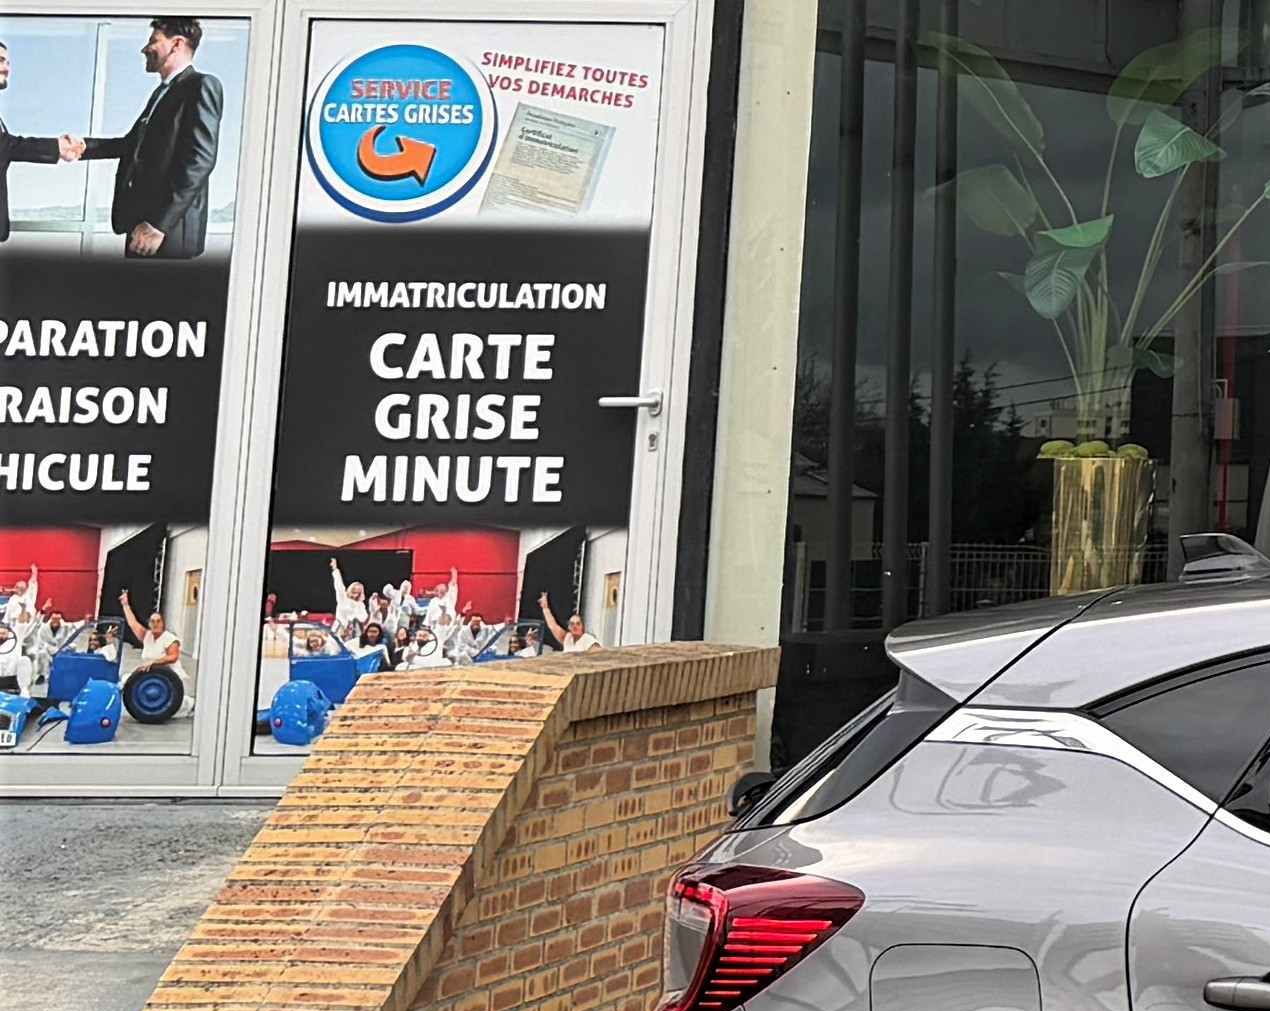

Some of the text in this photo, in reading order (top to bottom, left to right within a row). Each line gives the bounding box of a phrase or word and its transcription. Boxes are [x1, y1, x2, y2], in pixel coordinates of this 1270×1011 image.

[481, 51, 649, 89] SIMPLIFIEZ TOUTES
[351, 79, 452, 102] SERVICE
[488, 74, 635, 109] VOS DEMARCHES
[324, 103, 474, 126] CARTES GRISES
[326, 281, 607, 310] IMMATRICULATION
[0, 320, 207, 358] ARATION
[369, 332, 555, 380] CARTE
[374, 393, 541, 440] GRISE
[340, 455, 565, 502] MINUTE
